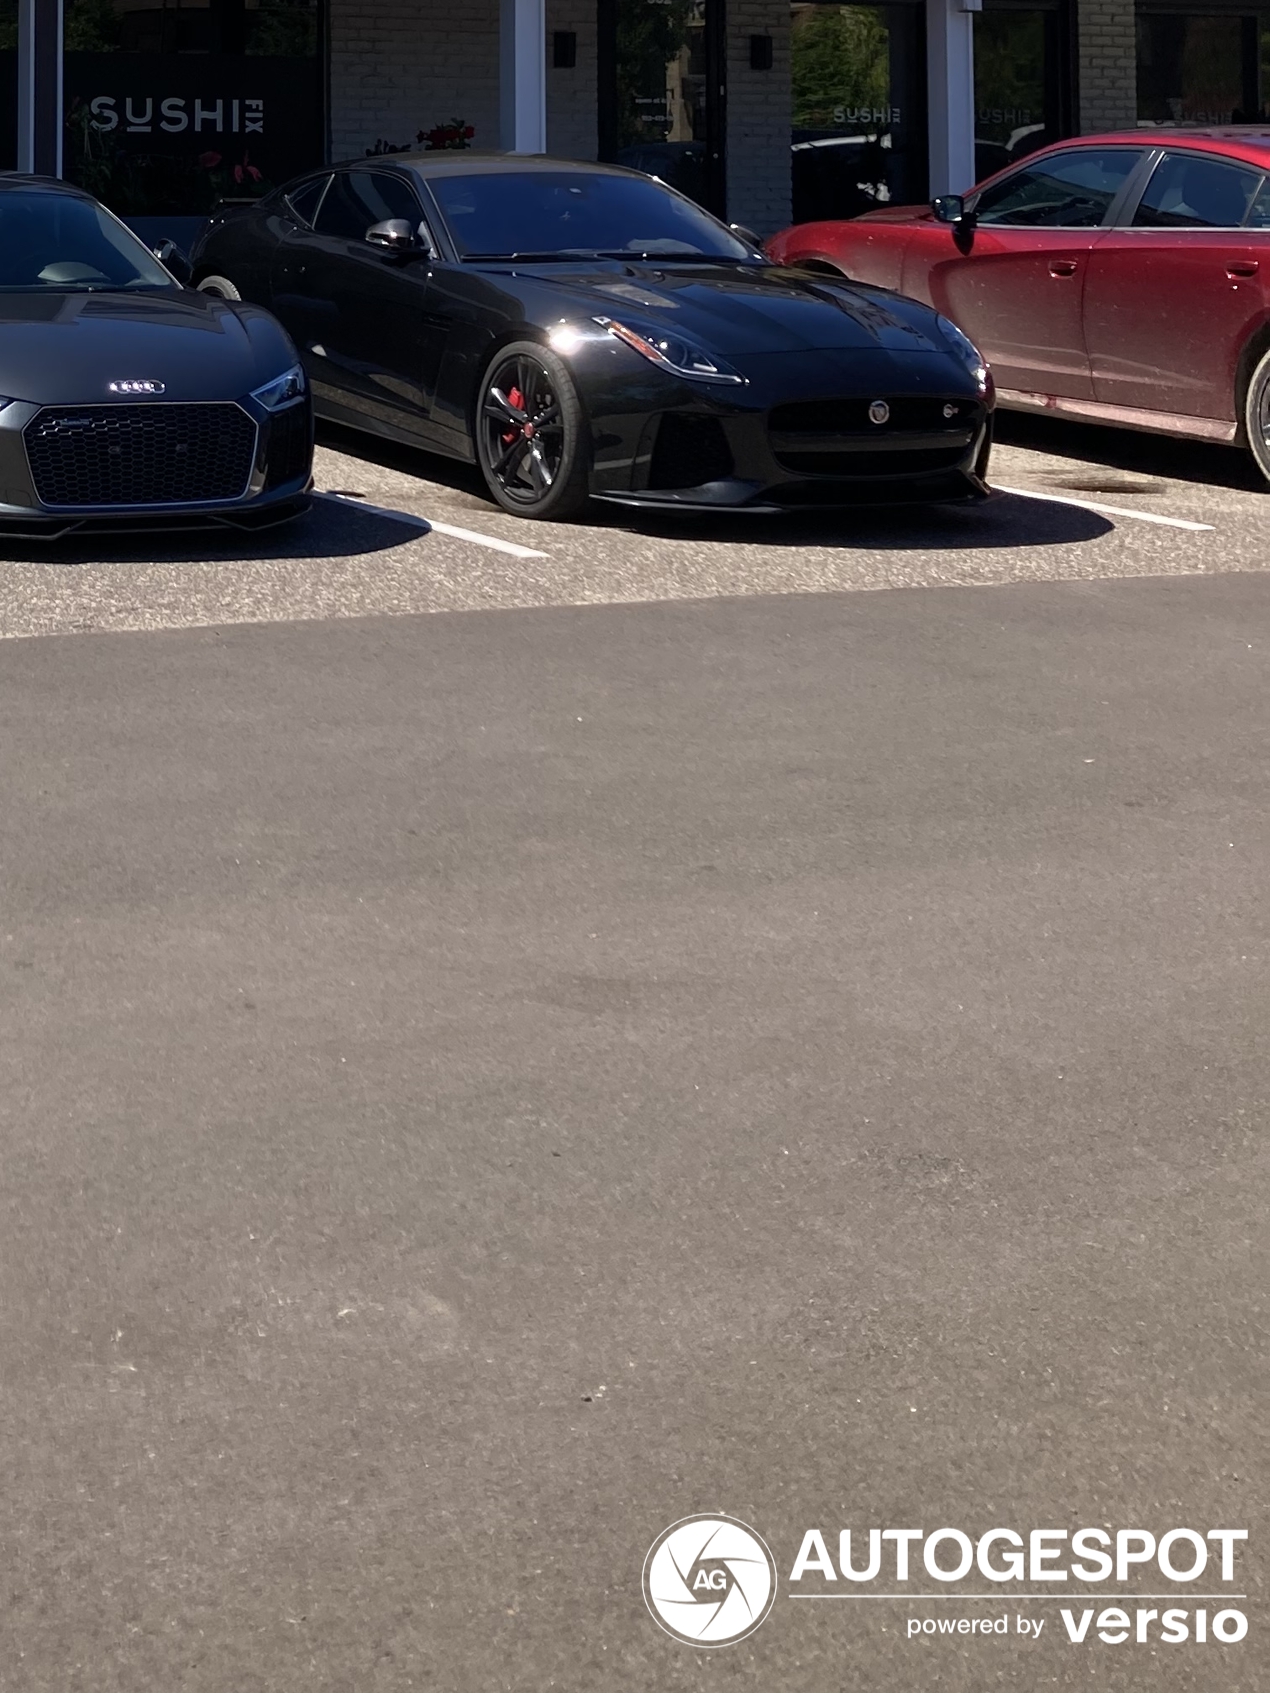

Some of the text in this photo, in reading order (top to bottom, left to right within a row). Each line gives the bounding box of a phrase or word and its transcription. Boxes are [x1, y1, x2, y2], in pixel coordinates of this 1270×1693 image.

[90, 95, 264, 133] SUSHI FIX
[833, 107, 891, 123] SUSHI
